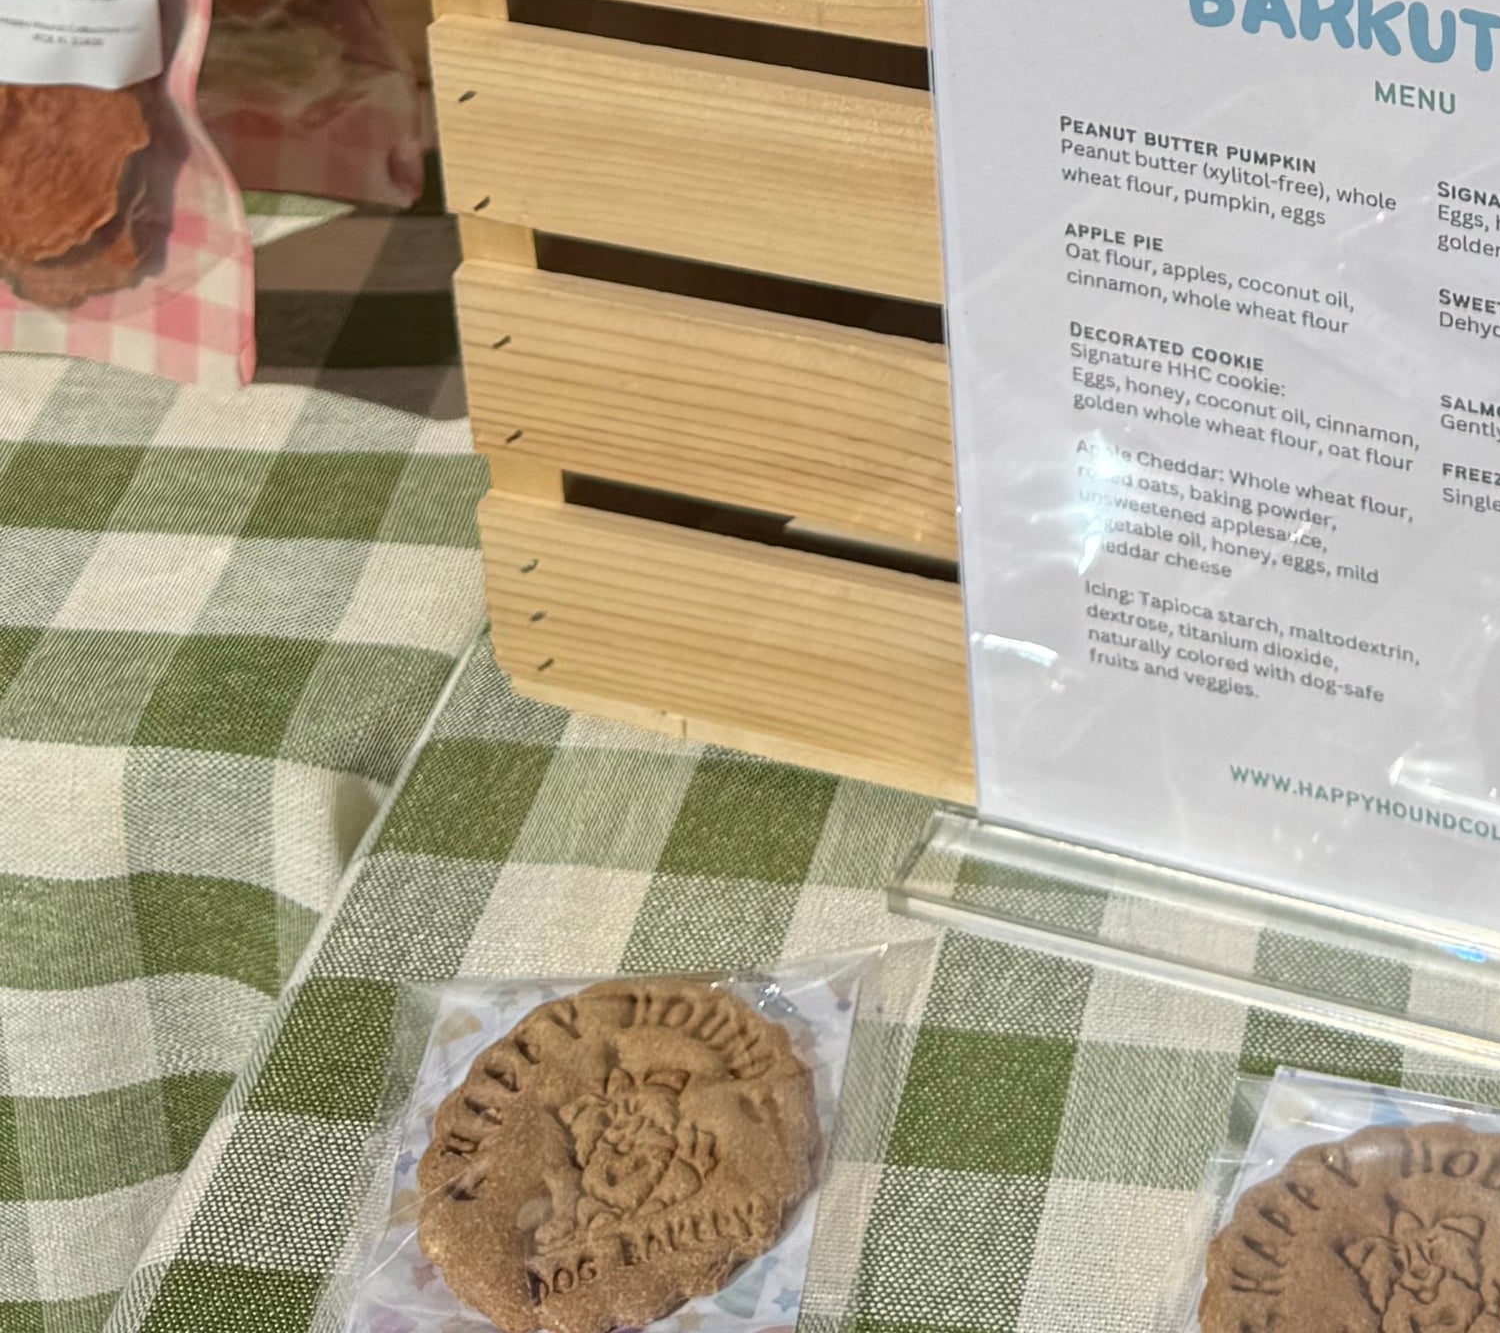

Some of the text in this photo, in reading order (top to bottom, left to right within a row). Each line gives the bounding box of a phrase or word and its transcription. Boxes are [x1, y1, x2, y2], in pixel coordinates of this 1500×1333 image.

[1374, 80, 1457, 115] MENU
[1059, 114, 1316, 175] PEANUT BUTTER PUMPKIN
[1060, 137, 1397, 212] Peanut butter (xylitol-free), whole
[1060, 166, 1327, 228] wheat flour, pumpkin, eggs
[1437, 203, 1490, 233] Eggs,
[1064, 222, 1164, 253] APPLE PIE
[1064, 242, 1355, 314] Oat flour, apples, coconut oil,
[1065, 268, 1350, 335] cinnamon, whole wheat flour
[1069, 320, 1265, 373] DECORATED COOKIE
[1070, 342, 1286, 398] Signature HHC cookie:
[1071, 365, 1420, 453] Eggs, honey, coconut oil, cinnamon,
[1072, 393, 1415, 472] golden whole wheat flour, oat flour
[1136, 450, 1225, 483] Cheddar:
[1228, 468, 1291, 495] Whole
[1294, 484, 1356, 509] wheat
[1359, 494, 1414, 524] flour,
[1137, 477, 1185, 502] oats,
[1189, 484, 1254, 517] baking
[1256, 497, 1337, 533] powder,
[1089, 533, 1233, 579] eddar cheese
[1177, 531, 1207, 552] oil,
[1211, 535, 1278, 567] honey,
[1281, 553, 1332, 578] eggs,
[1336, 564, 1380, 585] mild
[1084, 579, 1420, 667] Icing: Tapioca starch, maltodextrin,
[1085, 603, 1339, 673] dextrose, titanium dioxide,
[1087, 628, 1385, 704] naturally colored with dog-safe
[1089, 647, 1260, 699] fruits and veggies.
